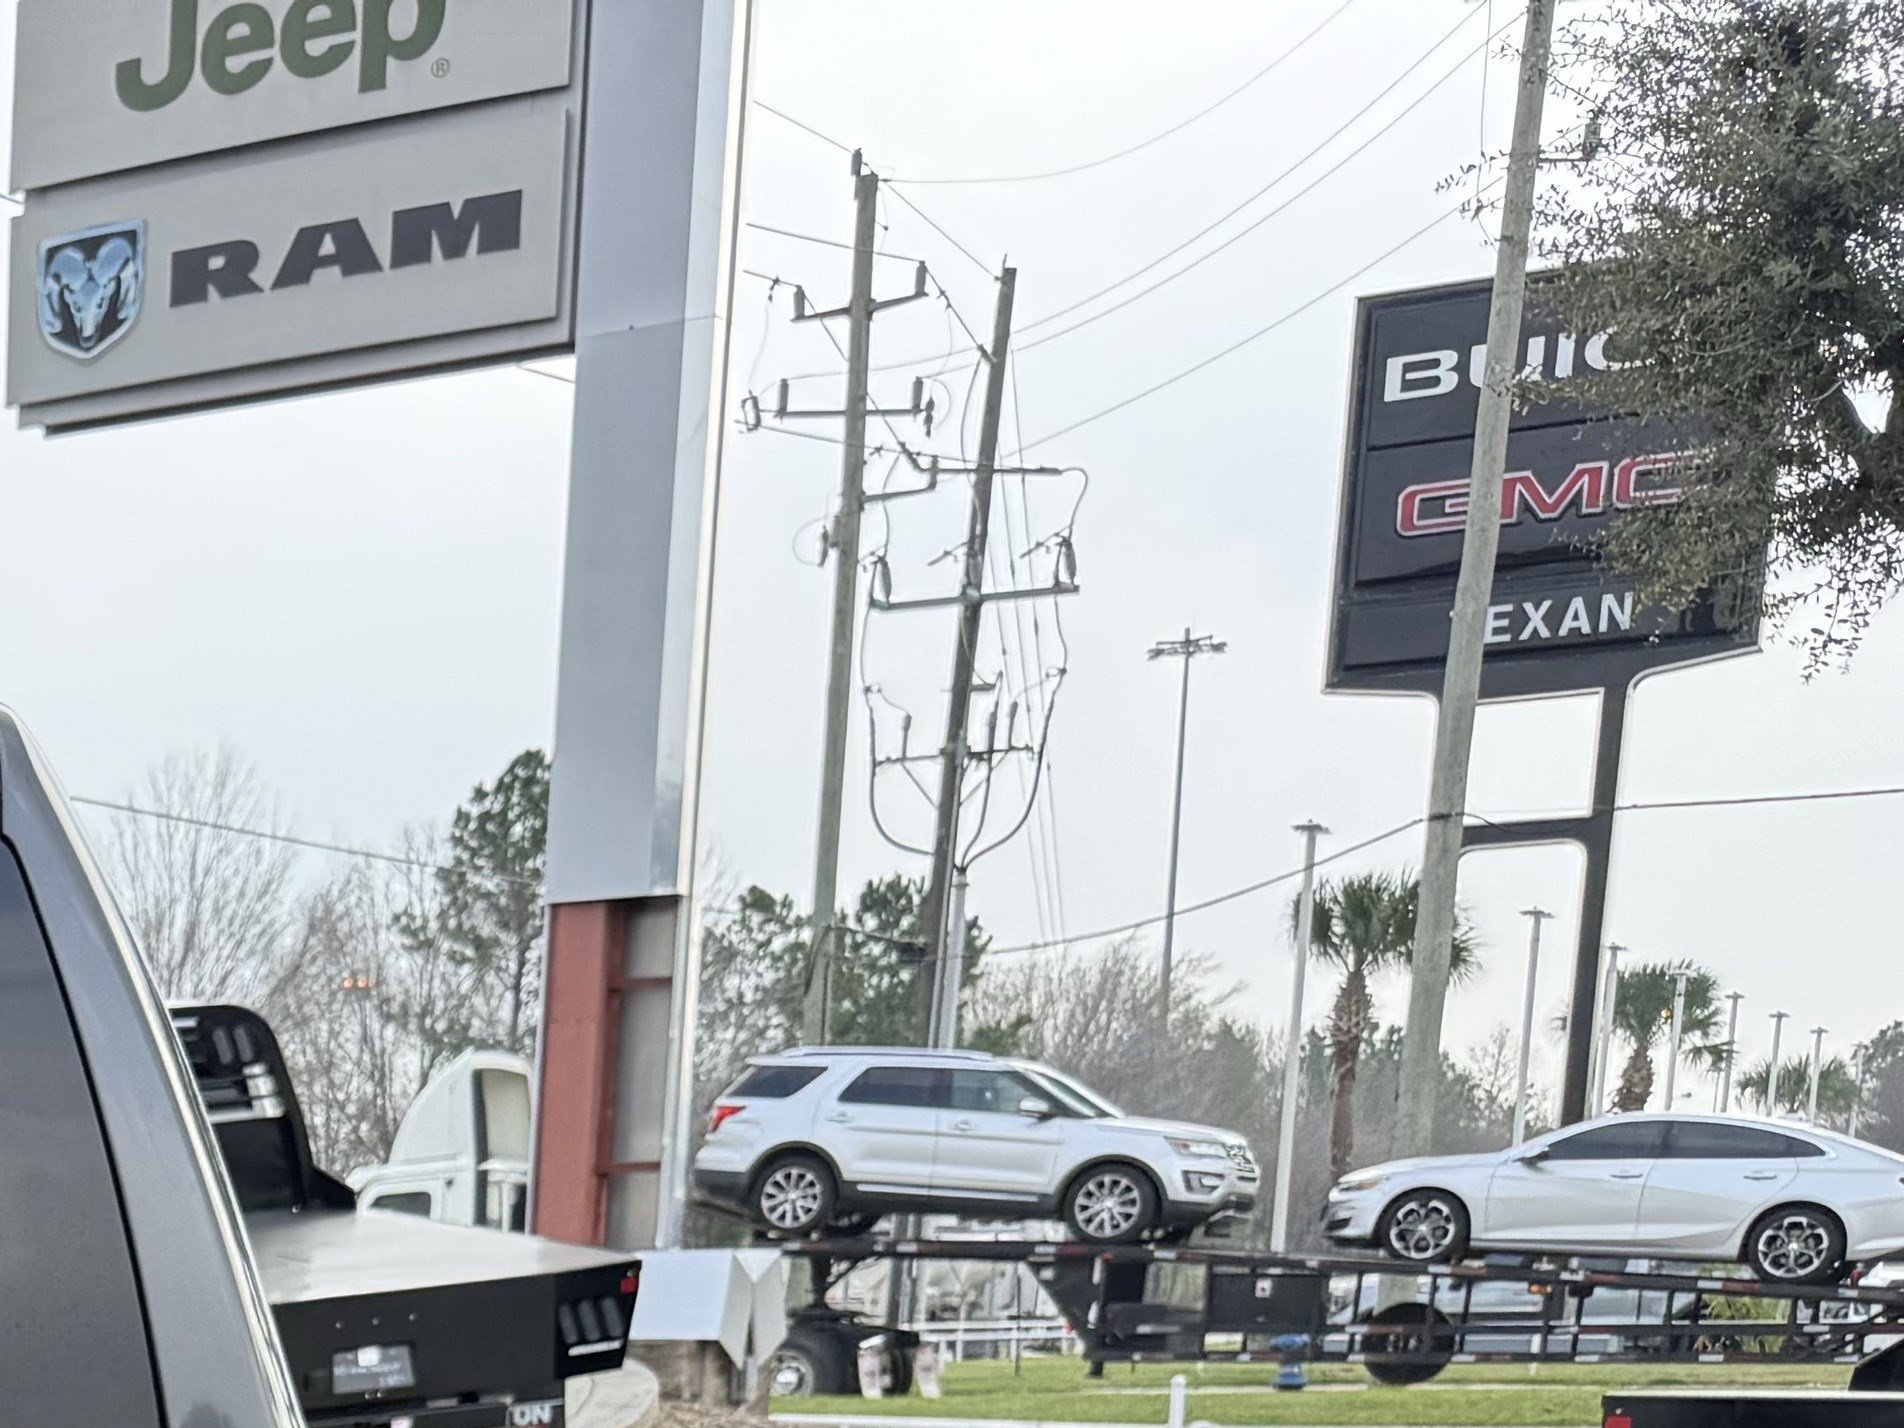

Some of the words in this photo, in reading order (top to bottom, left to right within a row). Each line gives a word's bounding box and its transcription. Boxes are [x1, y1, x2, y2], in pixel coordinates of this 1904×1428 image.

[114, 0, 446, 112] Jeep
[168, 189, 524, 309] RAM
[1482, 591, 1634, 645] EXAN
